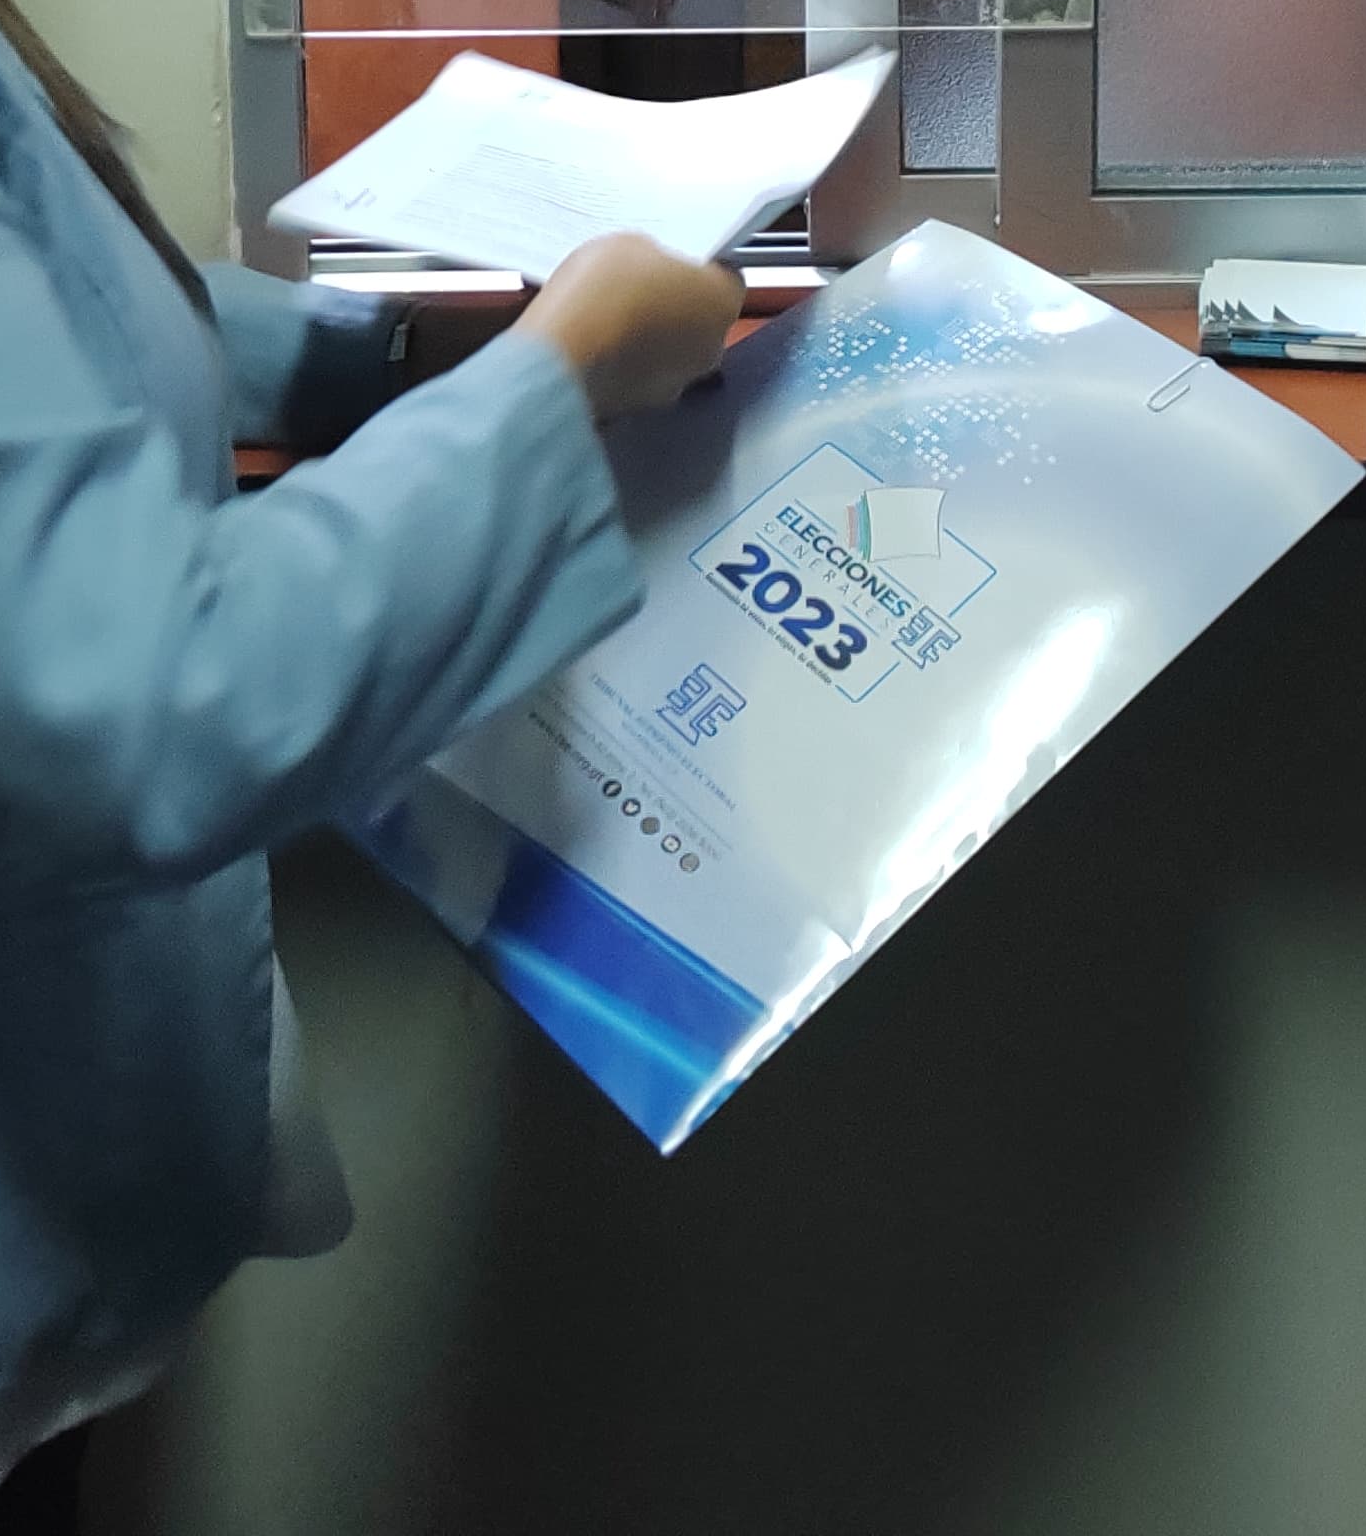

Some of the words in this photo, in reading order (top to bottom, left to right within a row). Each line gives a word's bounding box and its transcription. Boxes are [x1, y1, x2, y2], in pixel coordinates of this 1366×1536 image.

[715, 543, 868, 672] 2023
[762, 521, 892, 630] GENERALES
[776, 505, 913, 619] ELECCIONES
